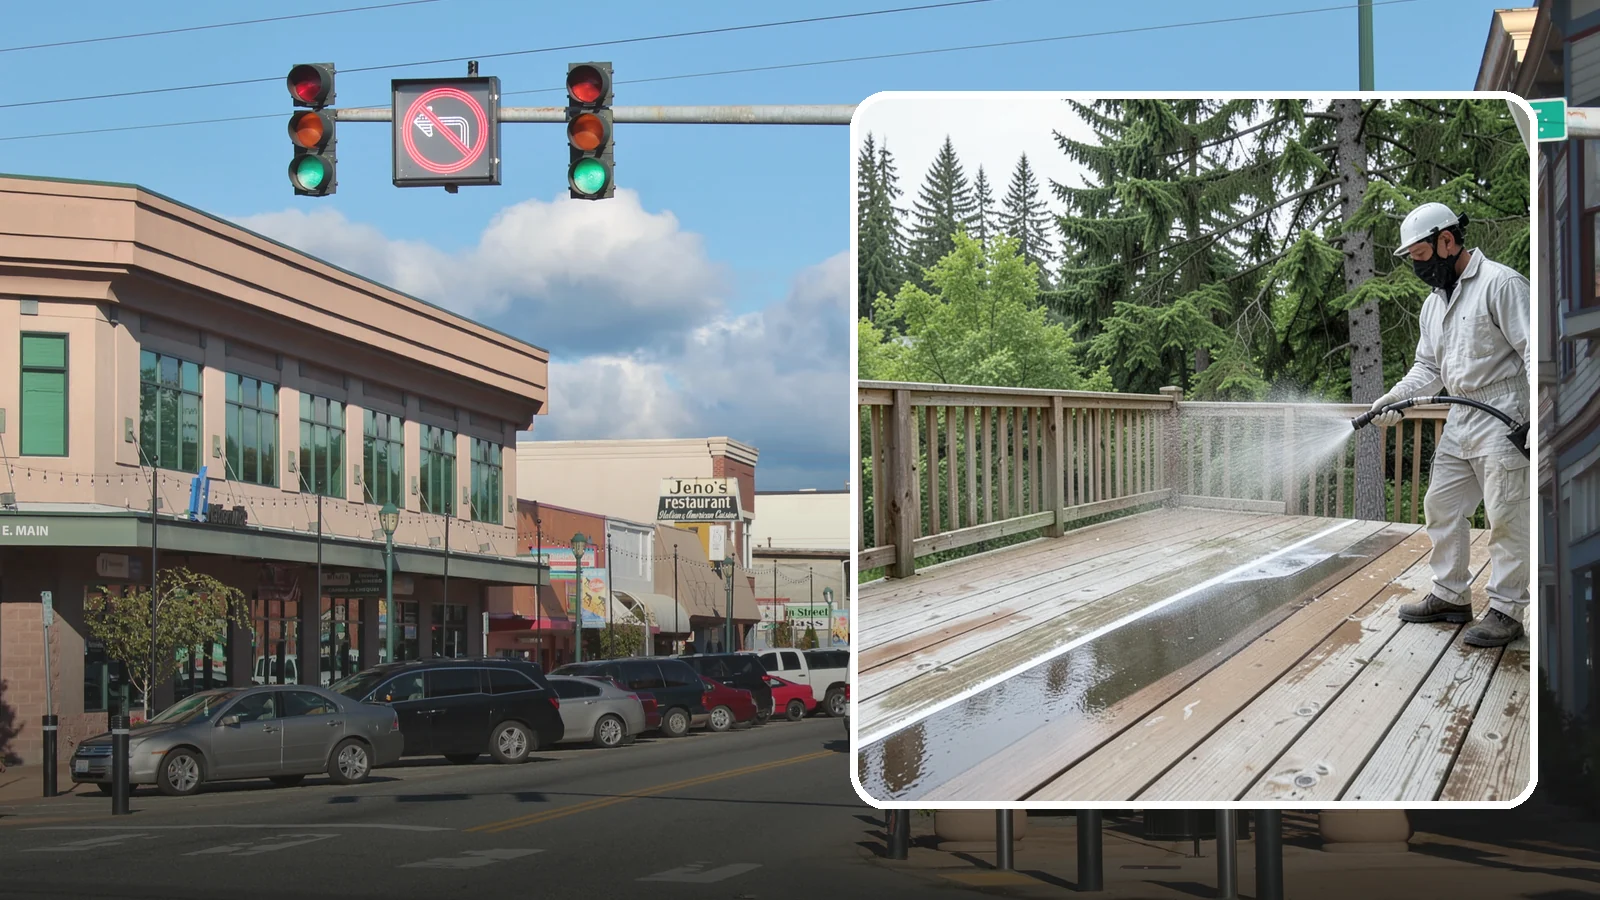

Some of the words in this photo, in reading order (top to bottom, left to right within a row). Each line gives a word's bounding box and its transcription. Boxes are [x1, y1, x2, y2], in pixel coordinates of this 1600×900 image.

[669, 480, 727, 494] Jeno's
[665, 496, 731, 509] restaurant
[658, 510, 681, 519] Italian
[686, 510, 714, 519] American
[715, 510, 737, 519] Cuisine
[2, 525, 13, 536] E.
[15, 525, 49, 536] MAIN
[797, 607, 828, 617] Street
[791, 619, 823, 627] lass
